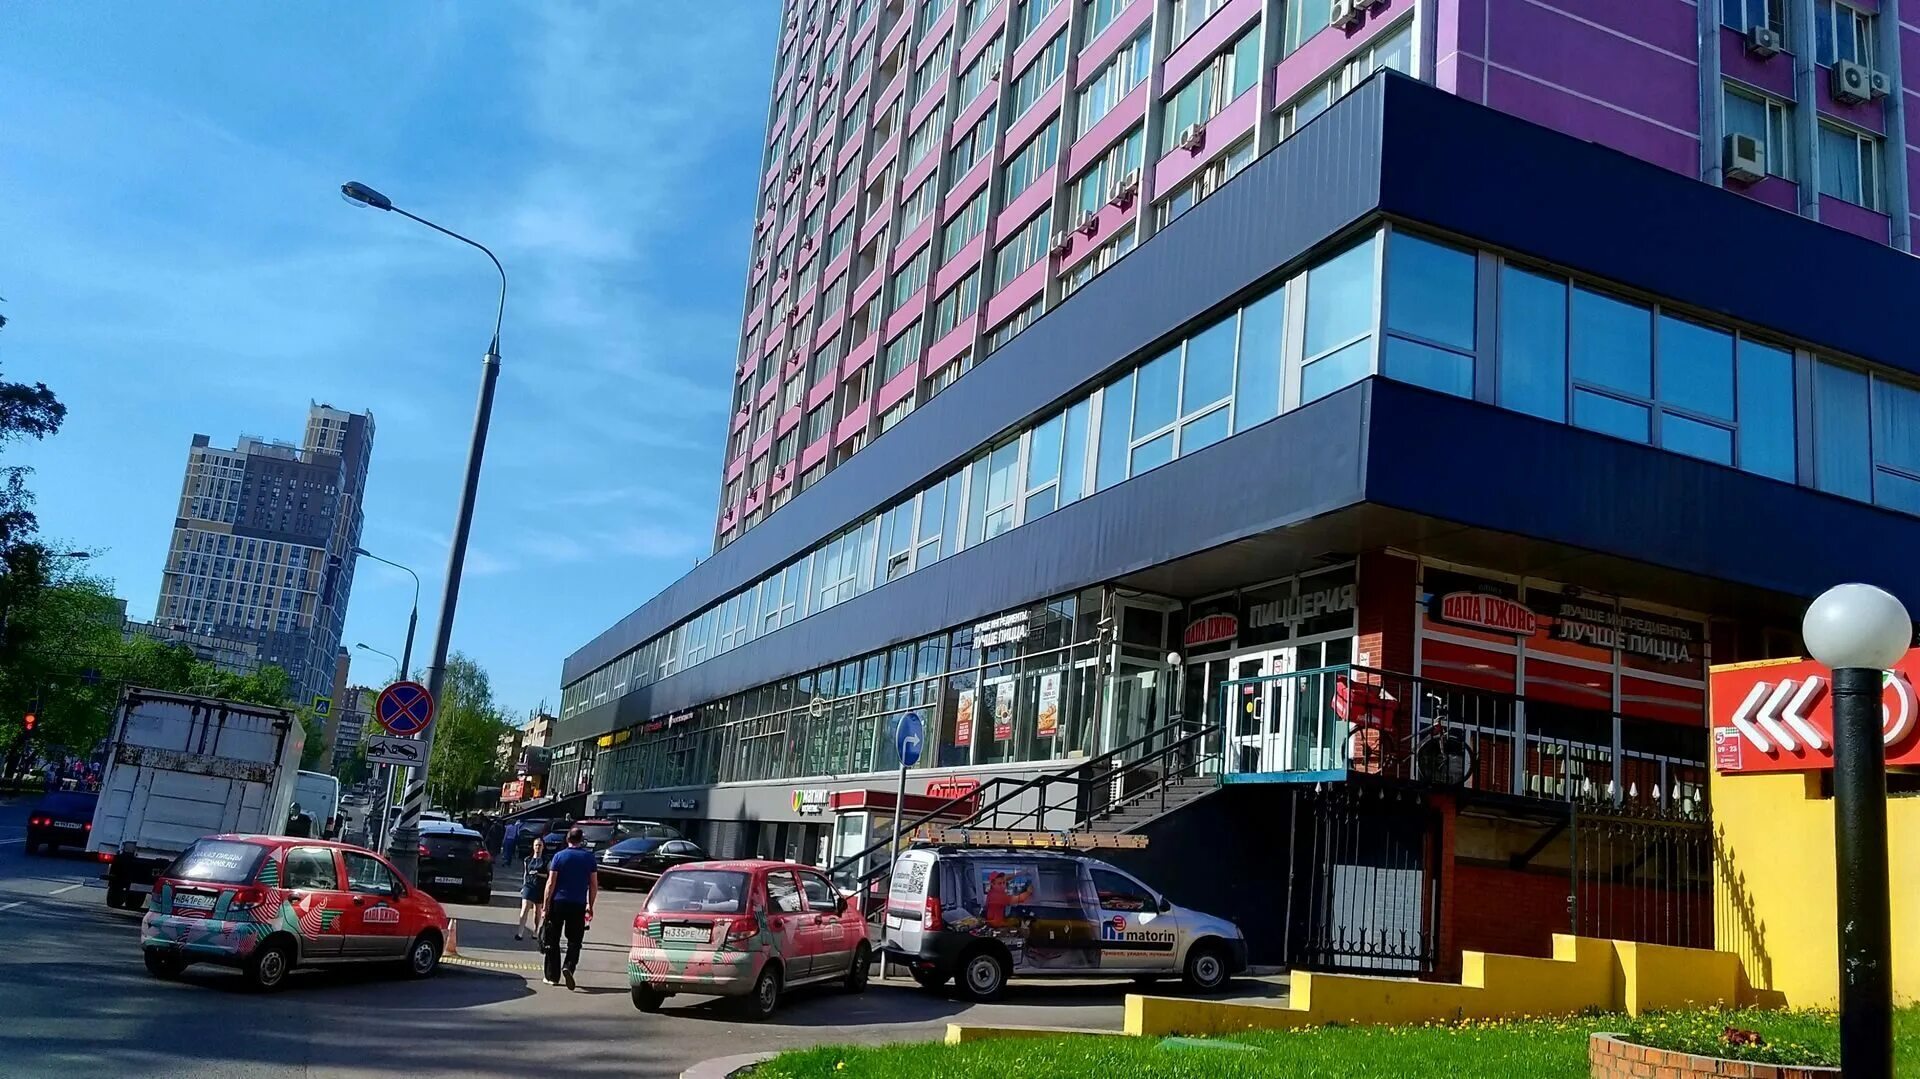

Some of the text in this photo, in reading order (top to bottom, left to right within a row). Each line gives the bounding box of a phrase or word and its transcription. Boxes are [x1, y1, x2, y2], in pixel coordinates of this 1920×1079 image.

[1249, 584, 1357, 628] ПИЦЦЕРИЯ
[1444, 595, 1535, 632] ПАПА ДЖОНС
[1559, 604, 1692, 640] ЛУЧШЕ ИНГРЕДИЕНТЫ.
[1186, 616, 1237, 644] ПАПА ДЖОНС
[1559, 620, 1693, 663] ЛУЧШЕ ПИЦЦА.
[1126, 930, 1175, 942] matorin
